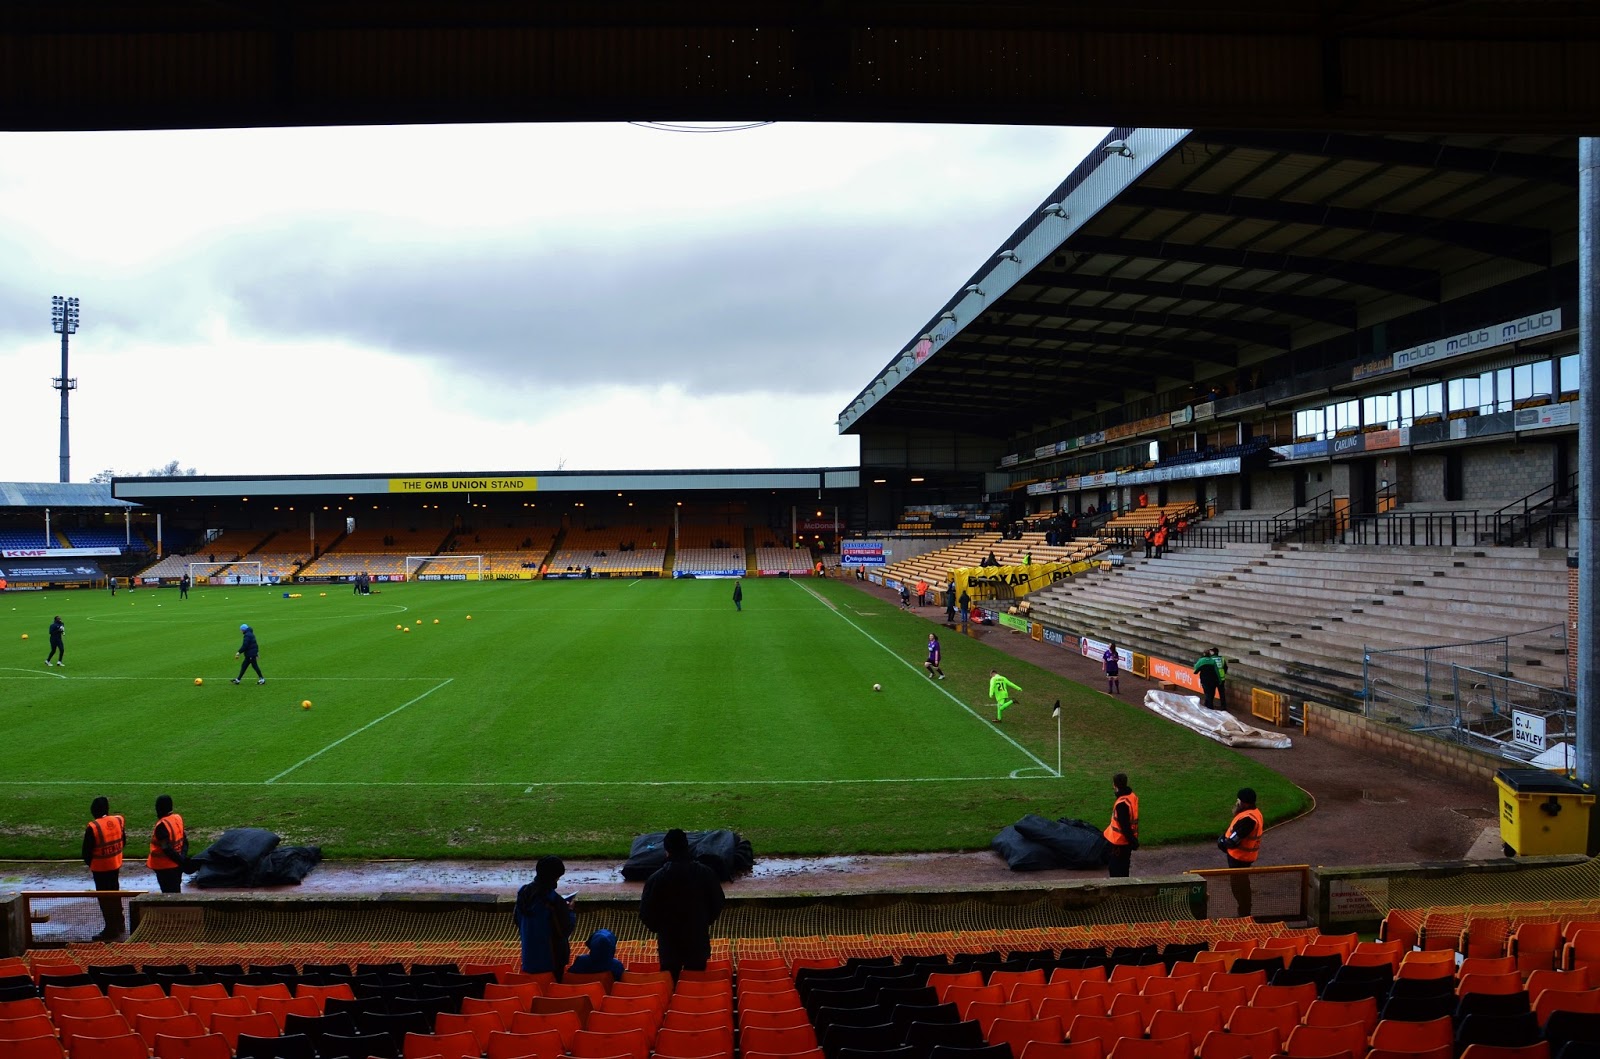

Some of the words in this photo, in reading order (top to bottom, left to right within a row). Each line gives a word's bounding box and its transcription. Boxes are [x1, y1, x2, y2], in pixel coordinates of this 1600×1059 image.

[1334, 435, 1358, 452] CARLING
[402, 481, 422, 490] THE
[425, 481, 449, 489] GMB
[452, 480, 487, 489] UNION
[491, 480, 524, 489] STAND
[1516, 717, 1523, 727] C.
[1525, 720, 1532, 729] J.
[1516, 730, 1543, 746] BAYLEY
